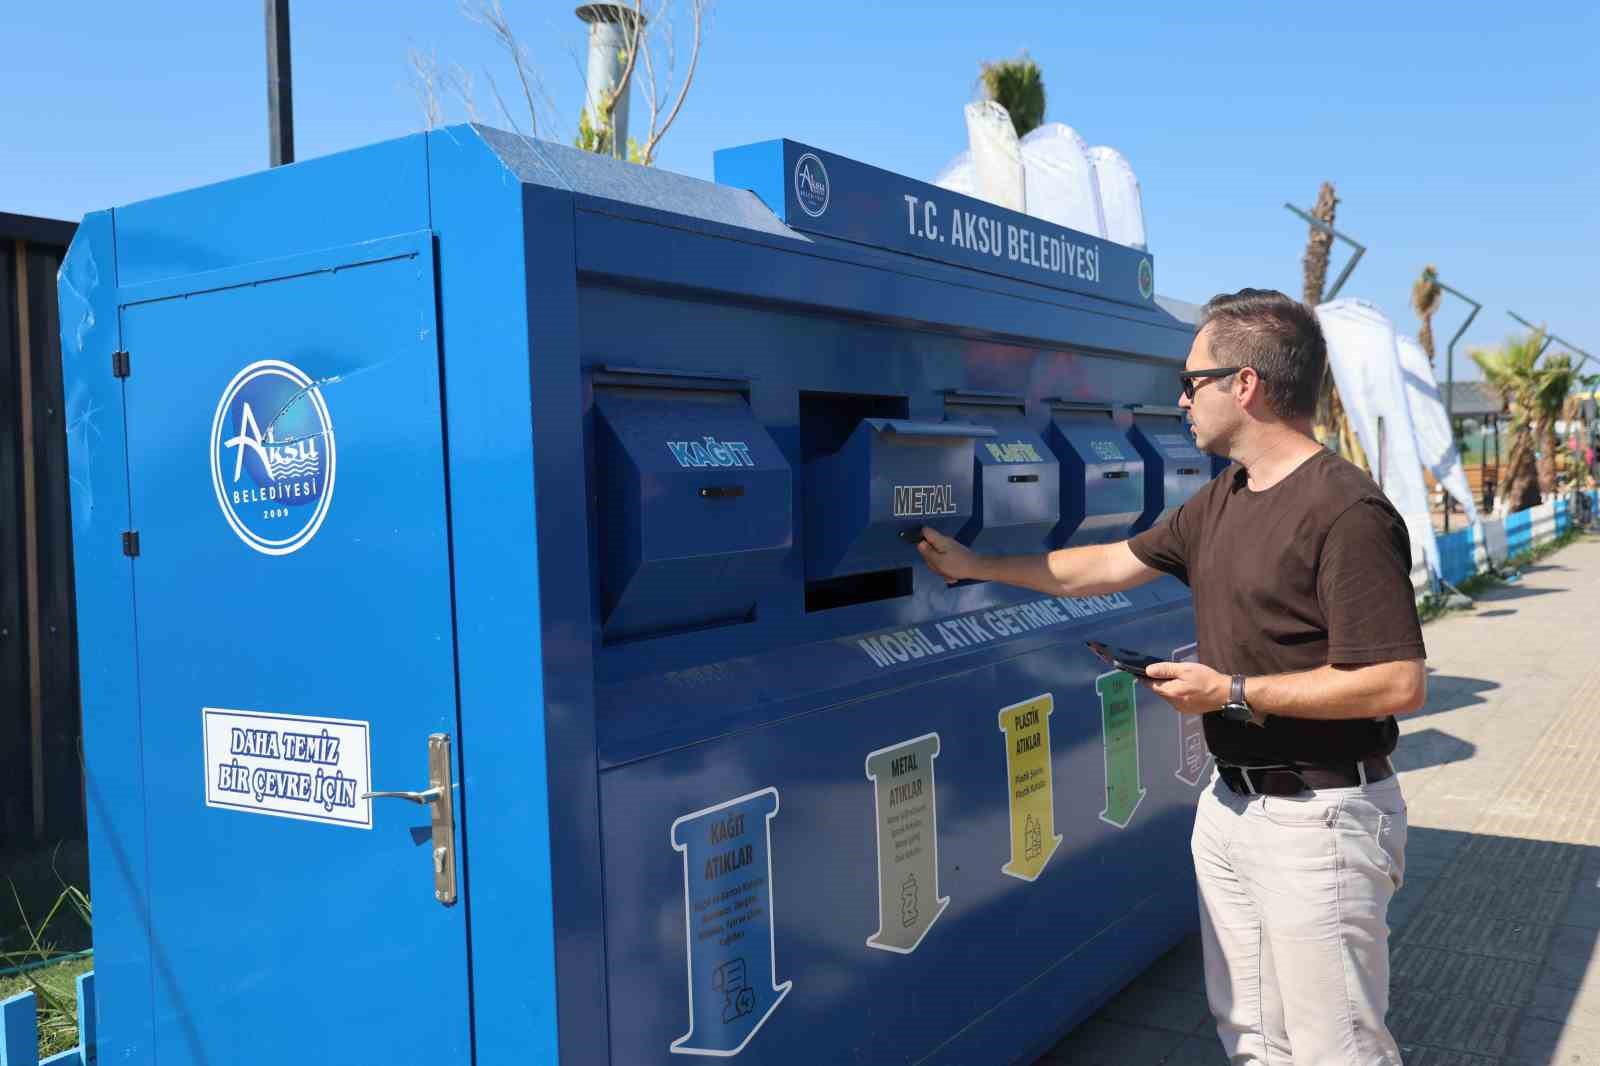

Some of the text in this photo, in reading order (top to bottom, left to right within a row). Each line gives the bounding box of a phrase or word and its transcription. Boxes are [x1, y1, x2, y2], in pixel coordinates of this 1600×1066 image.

[904, 194, 1101, 283] T.C. AKSU BELEDİYESİ
[224, 402, 320, 482] Aksu
[666, 436, 755, 467] KAĞIT
[233, 478, 318, 504] BELEDİYESİ
[893, 485, 957, 517] METAL
[263, 507, 289, 520] 2009
[935, 615, 995, 650] ATIK
[1015, 705, 1040, 731] PLASTİK
[230, 727, 341, 766] DAHA TEMİZ
[1016, 732, 1041, 754] ATIKLAR
[891, 752, 918, 777] METAL
[217, 758, 358, 812] BİR ÇEVRE İÇİN
[889, 778, 923, 809] ATIKLAR
[710, 811, 745, 846] KAĞIT
[704, 843, 753, 881] ATIKLAR
